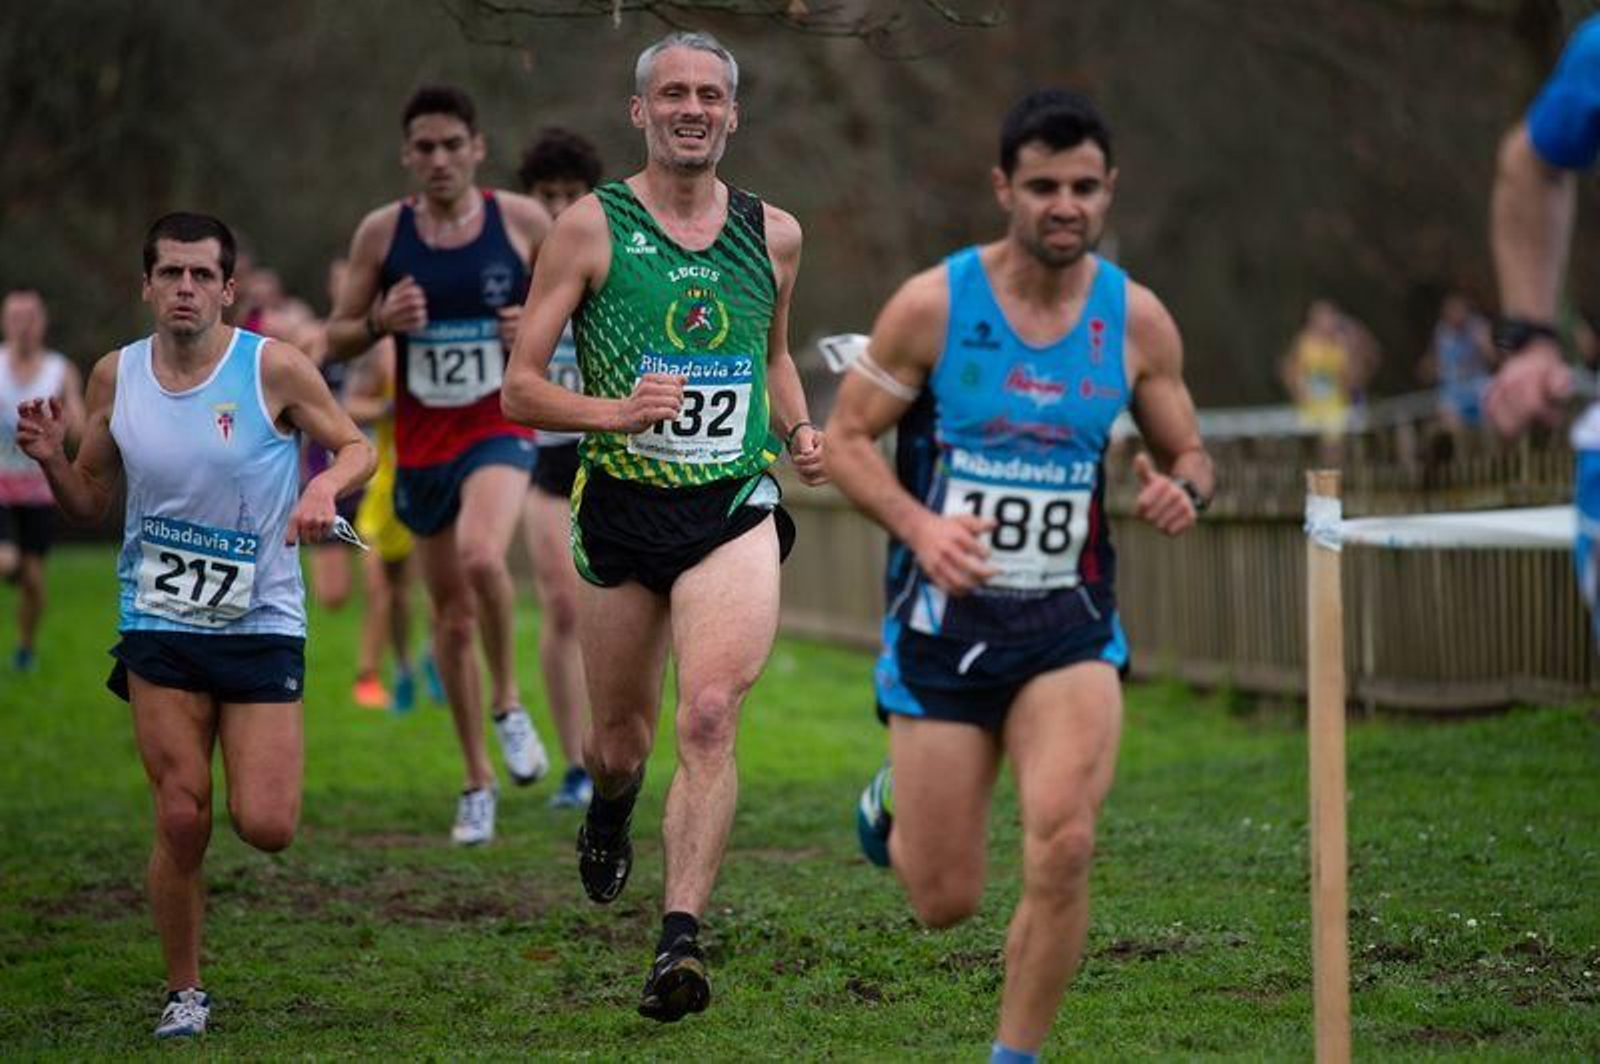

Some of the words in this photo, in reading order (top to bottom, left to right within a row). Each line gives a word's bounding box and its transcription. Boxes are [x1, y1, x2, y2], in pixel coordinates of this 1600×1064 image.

[423, 347, 486, 387] 121
[640, 354, 728, 378] Ribadavia
[733, 358, 752, 377] 22
[952, 448, 1067, 484] Ribadavia
[1070, 460, 1094, 485] 22
[143, 519, 229, 552] Ribadavia
[233, 536, 257, 556] 22
[154, 551, 239, 609] 217
